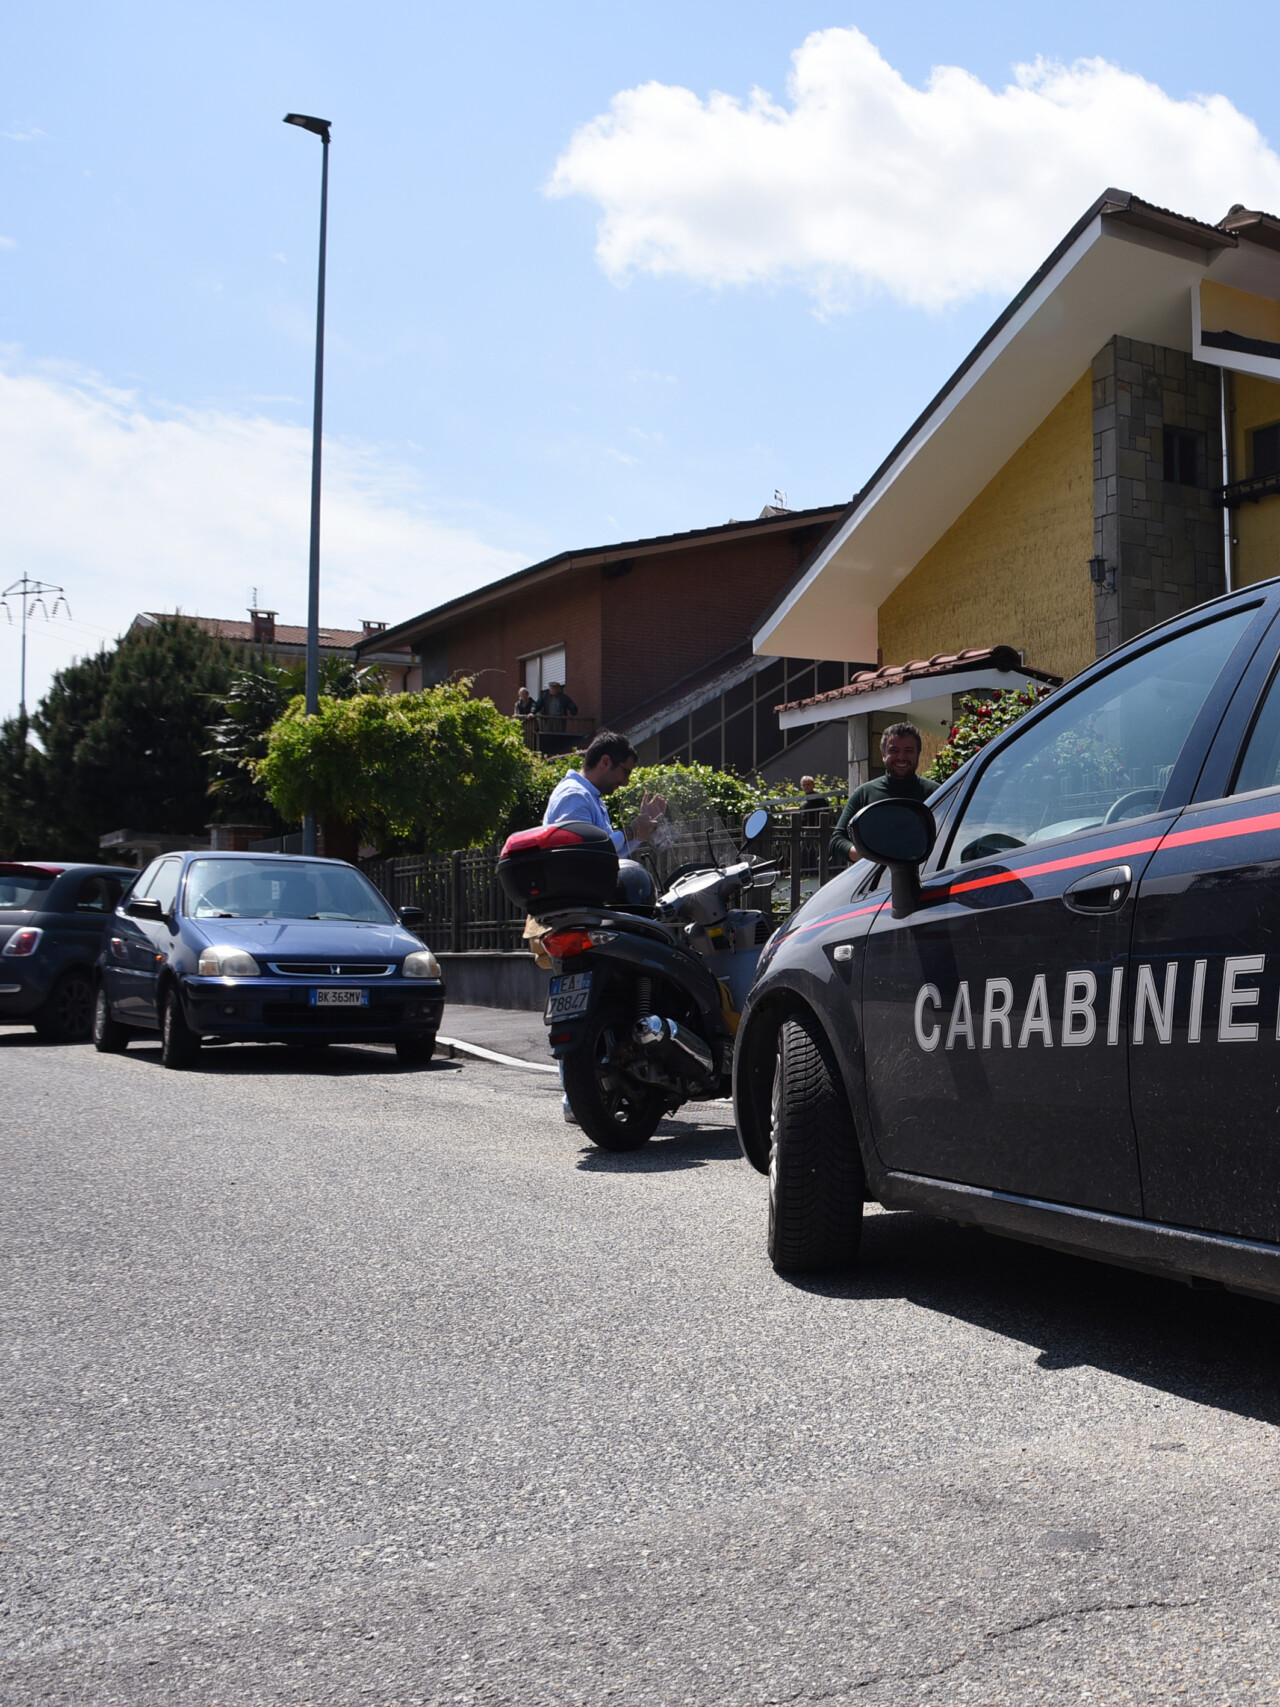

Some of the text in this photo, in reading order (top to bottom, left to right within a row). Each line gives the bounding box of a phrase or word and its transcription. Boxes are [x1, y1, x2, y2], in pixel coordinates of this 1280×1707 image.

[560, 976, 576, 992] EA
[318, 991, 330, 1003] BK
[331, 991, 361, 1003] 363MV
[549, 992, 588, 1015] 78847
